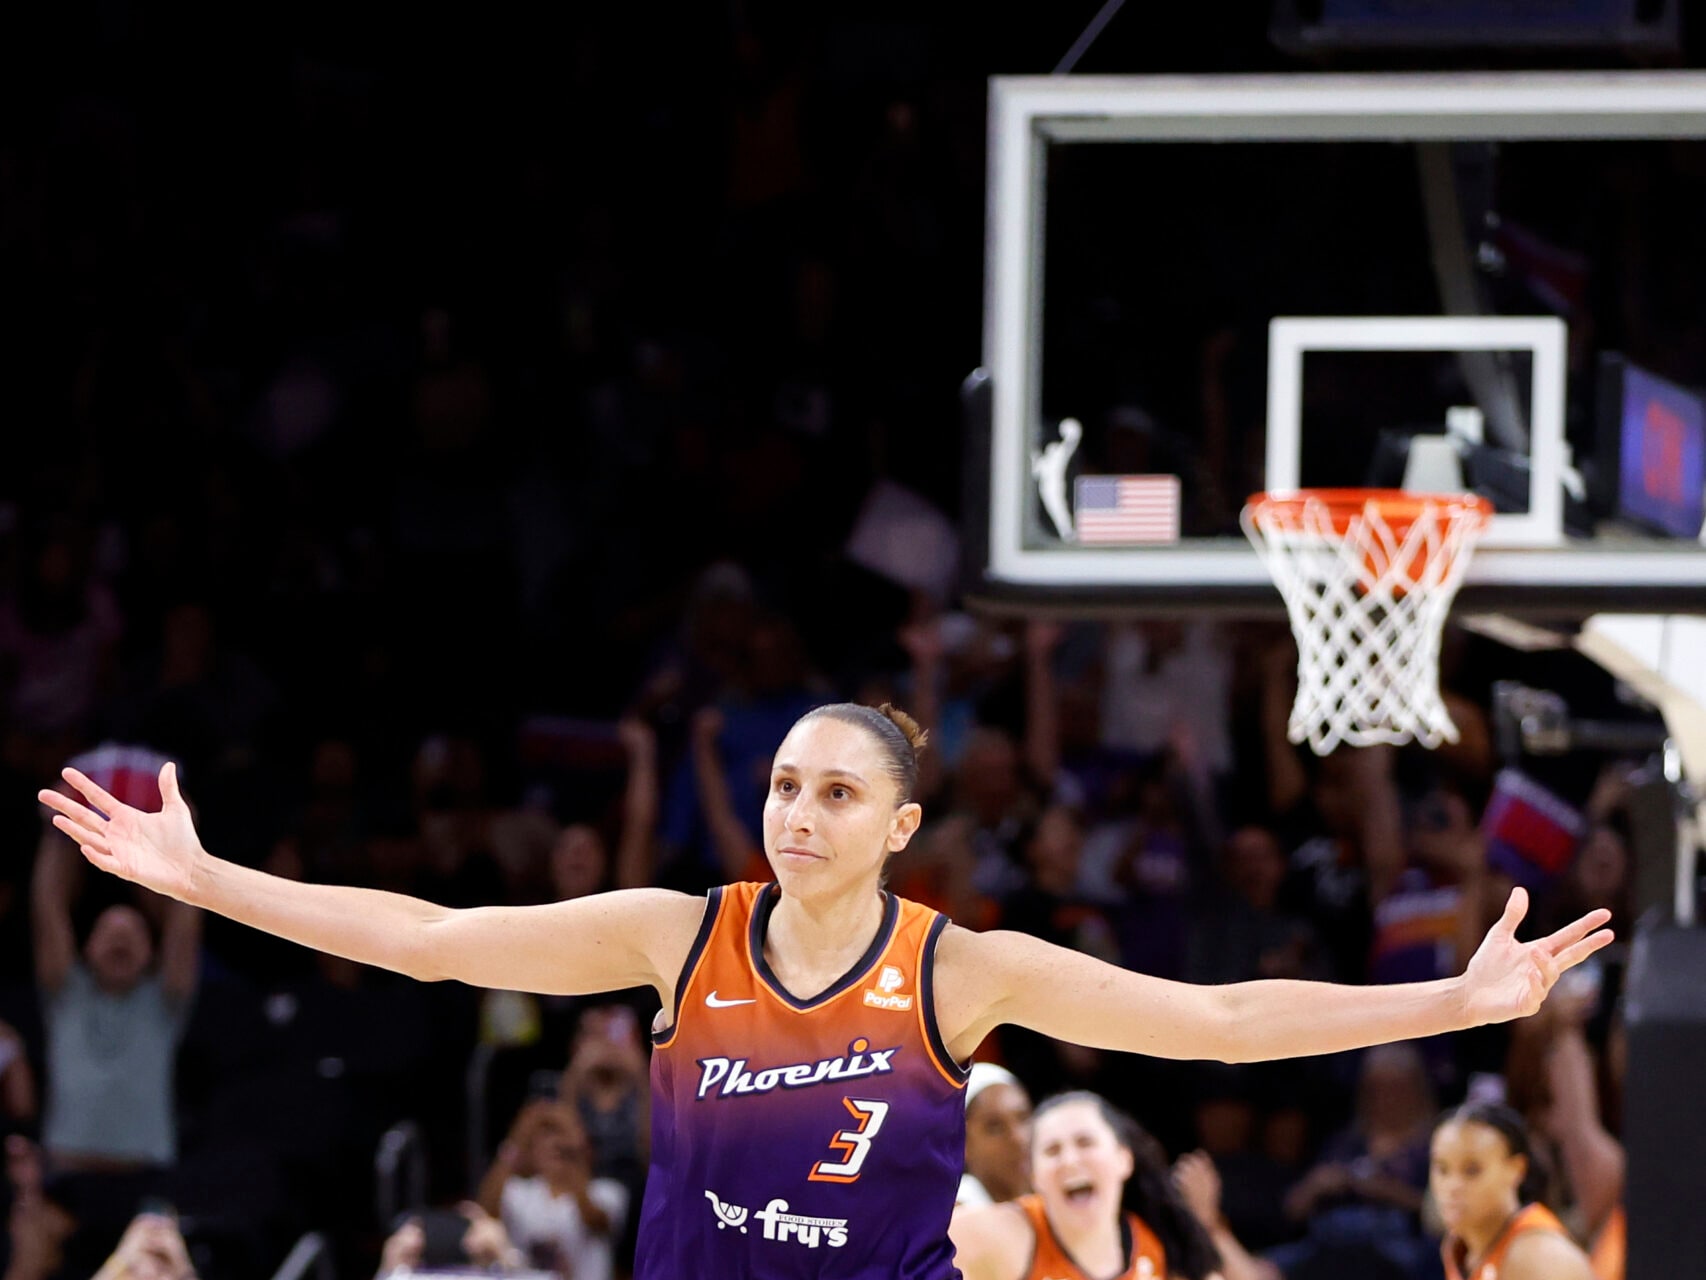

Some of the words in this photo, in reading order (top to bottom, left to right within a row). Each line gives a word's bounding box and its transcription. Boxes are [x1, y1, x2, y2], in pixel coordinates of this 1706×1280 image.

[865, 991, 911, 1009] PayPal
[696, 1038, 898, 1098] Phoenix
[808, 1096, 889, 1184] 3
[754, 1198, 849, 1248] fry's
